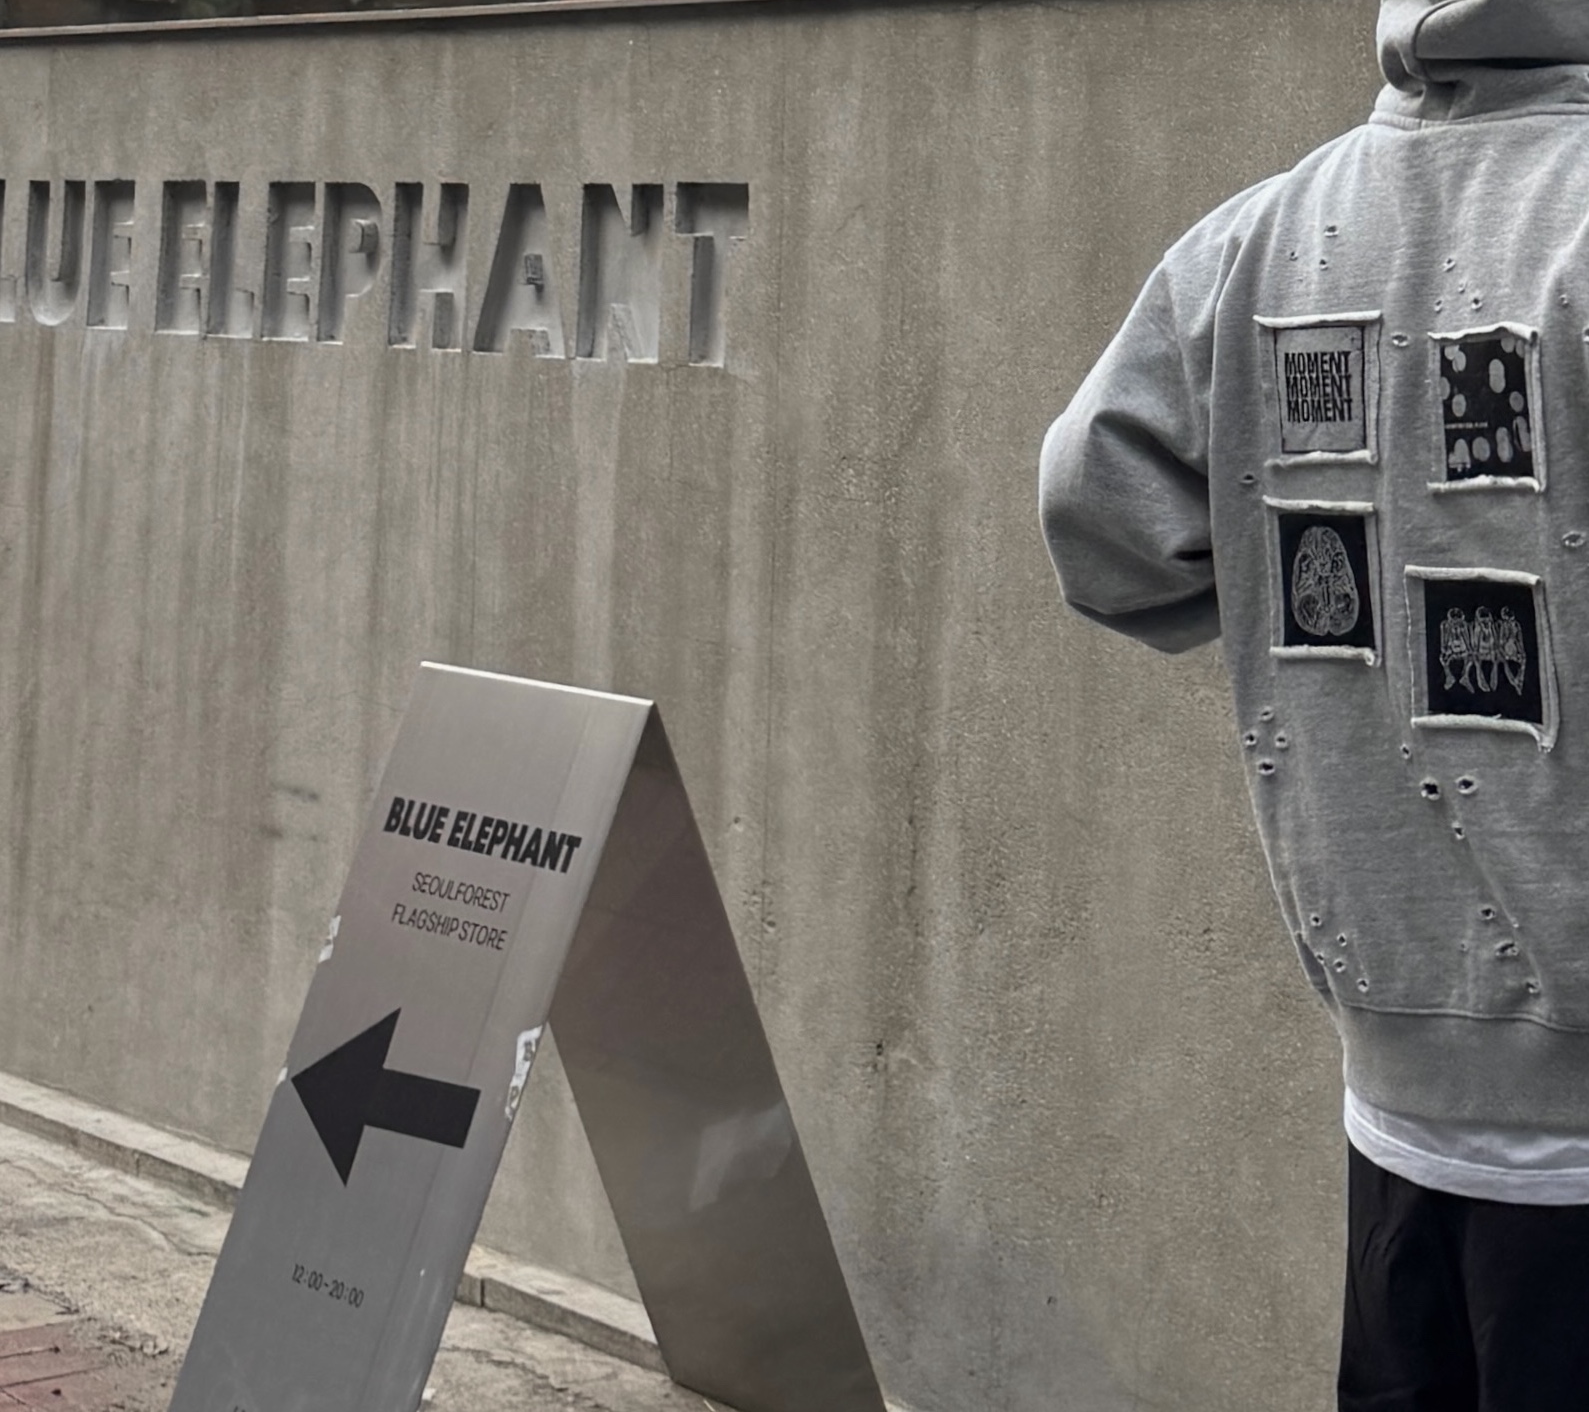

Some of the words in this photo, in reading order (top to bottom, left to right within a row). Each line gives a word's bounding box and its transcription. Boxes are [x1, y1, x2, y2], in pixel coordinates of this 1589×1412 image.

[154, 180, 749, 367] ELEPHANT
[1284, 351, 1352, 374] MOMENT
[1286, 374, 1352, 398] MOMENT
[1287, 398, 1353, 423] MOMENT
[384, 797, 450, 843] BLUE
[448, 811, 582, 873] ELEPHANT
[392, 903, 458, 936] FLAGSHIP
[458, 920, 508, 951] STORE
